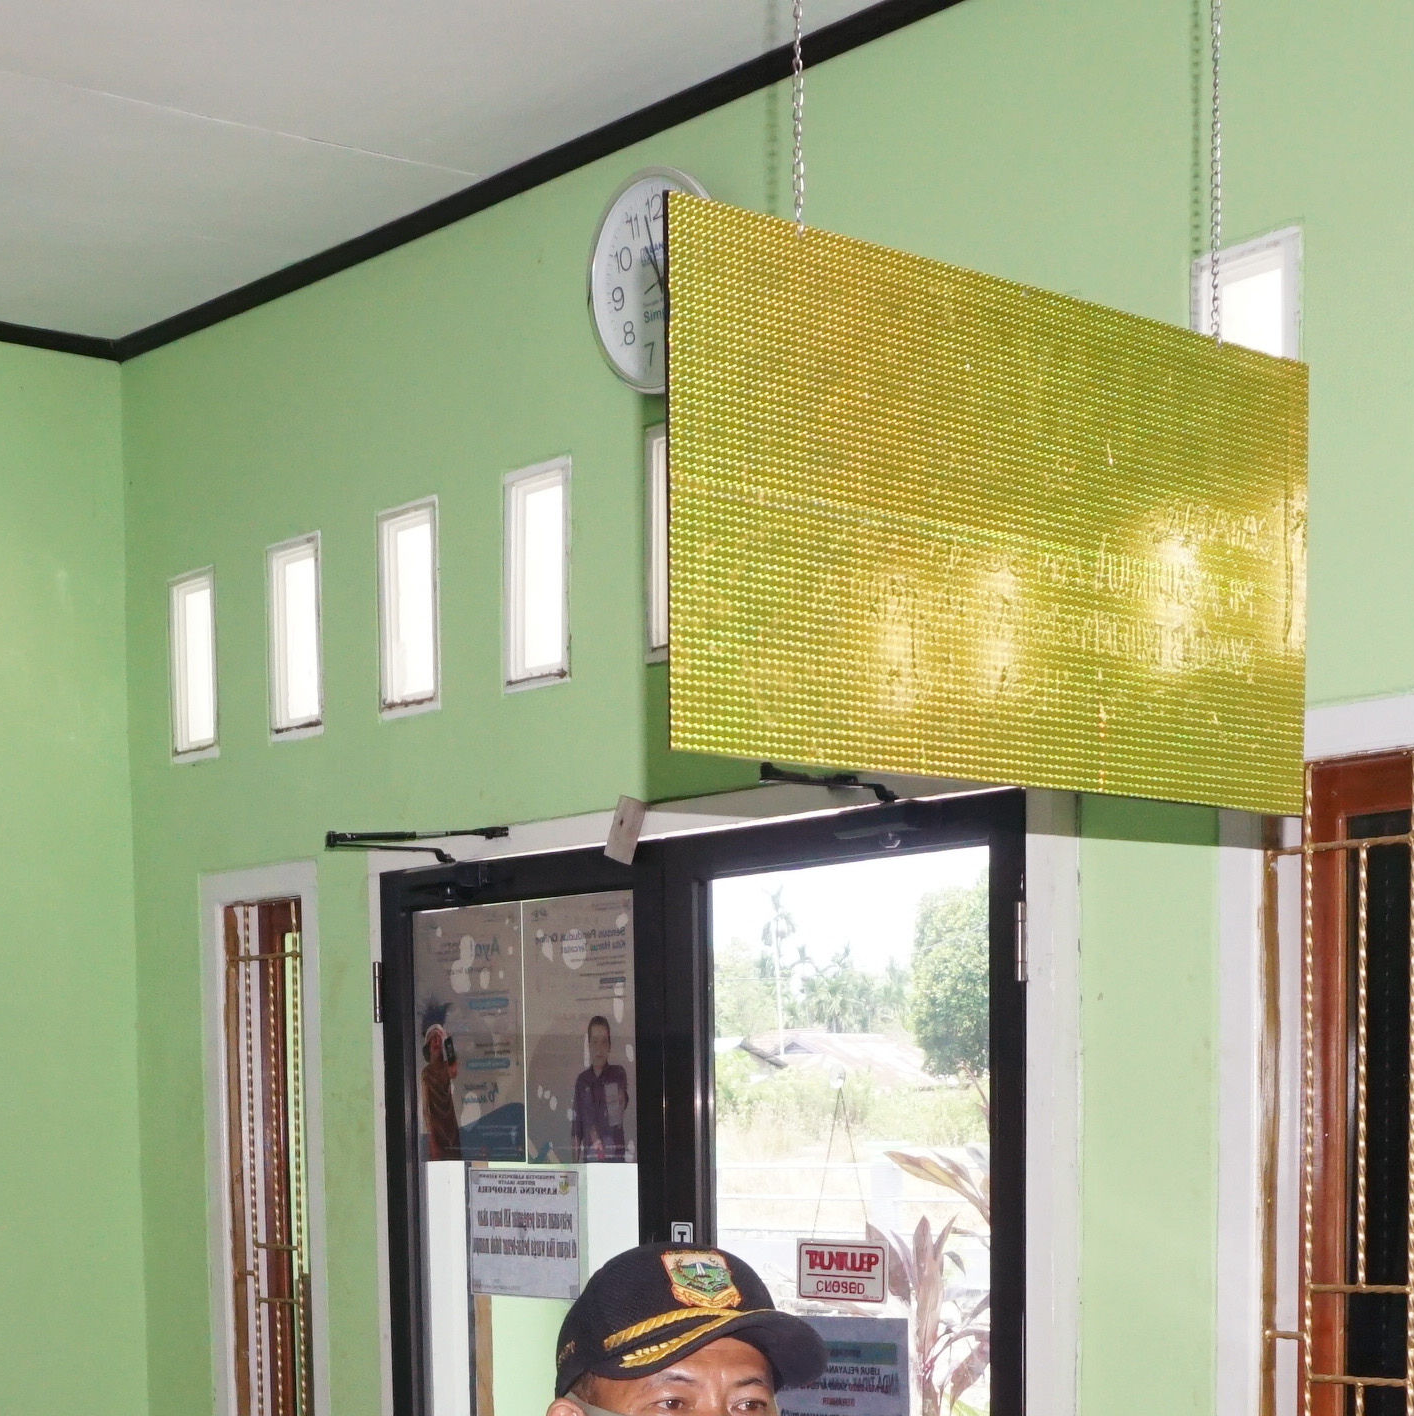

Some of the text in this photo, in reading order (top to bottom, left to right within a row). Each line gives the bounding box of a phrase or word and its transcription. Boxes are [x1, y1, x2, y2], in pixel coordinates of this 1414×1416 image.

[626, 212, 640, 240] 11
[614, 246, 633, 274] 10
[611, 286, 625, 311] 9
[623, 321, 636, 345] 8
[644, 341, 655, 367] 7
